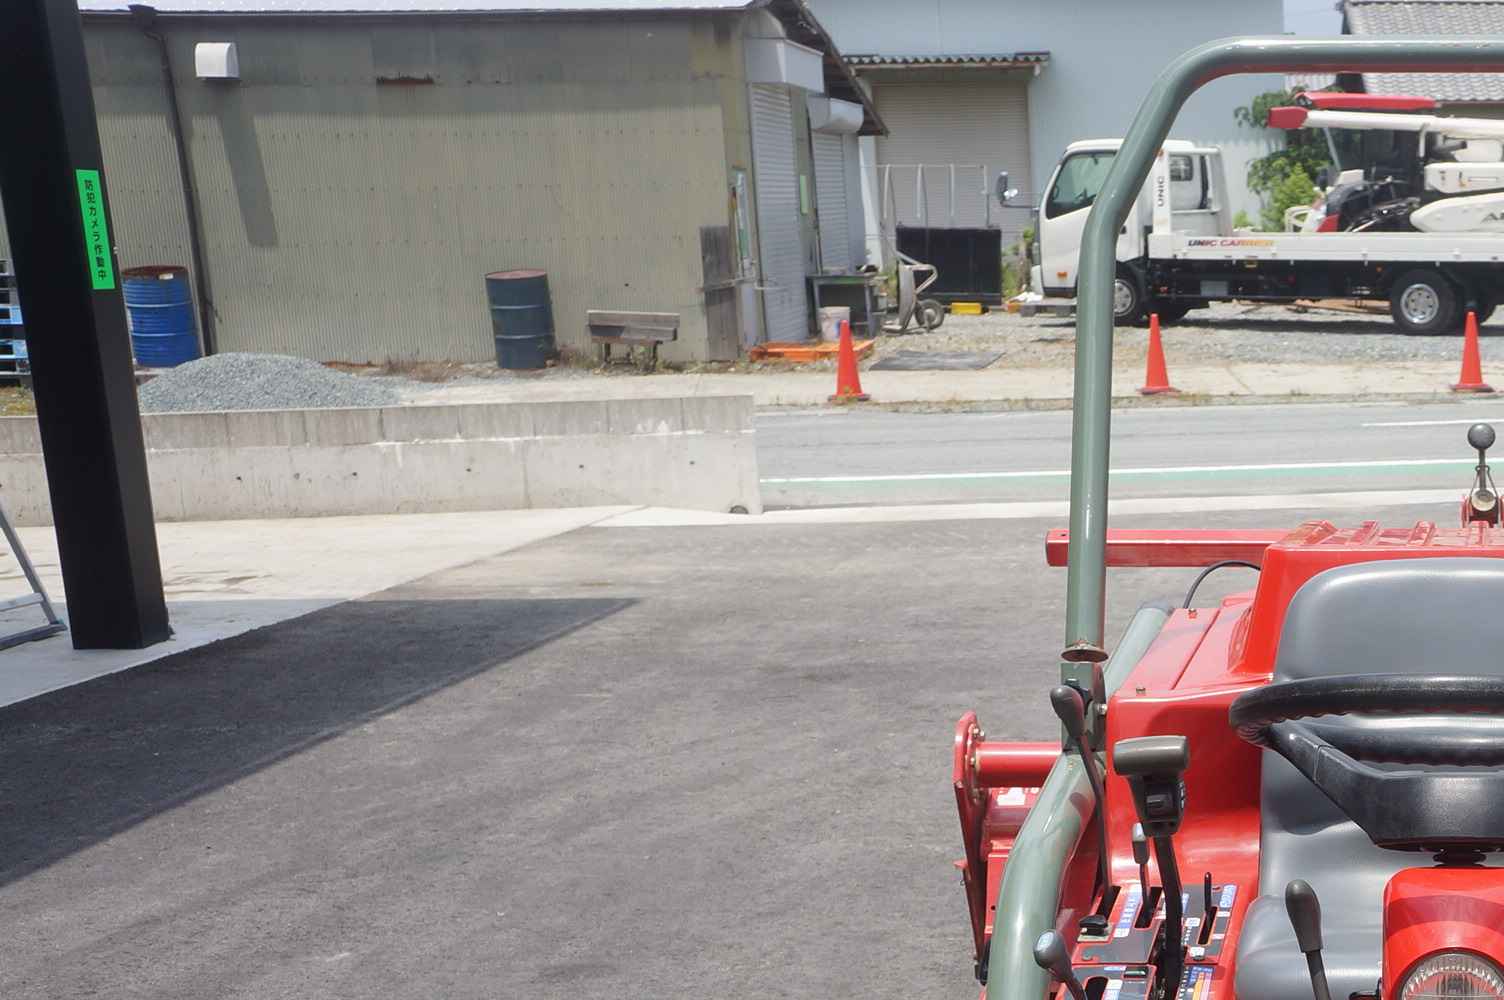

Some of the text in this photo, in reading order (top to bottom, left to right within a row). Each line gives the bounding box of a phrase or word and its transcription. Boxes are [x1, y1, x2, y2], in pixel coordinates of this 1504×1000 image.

[1157, 175, 1165, 207] UNIC
[84, 179, 107, 281] 防犯カメラ作動中
[1188, 239, 1275, 247] UNIC CARRIER
